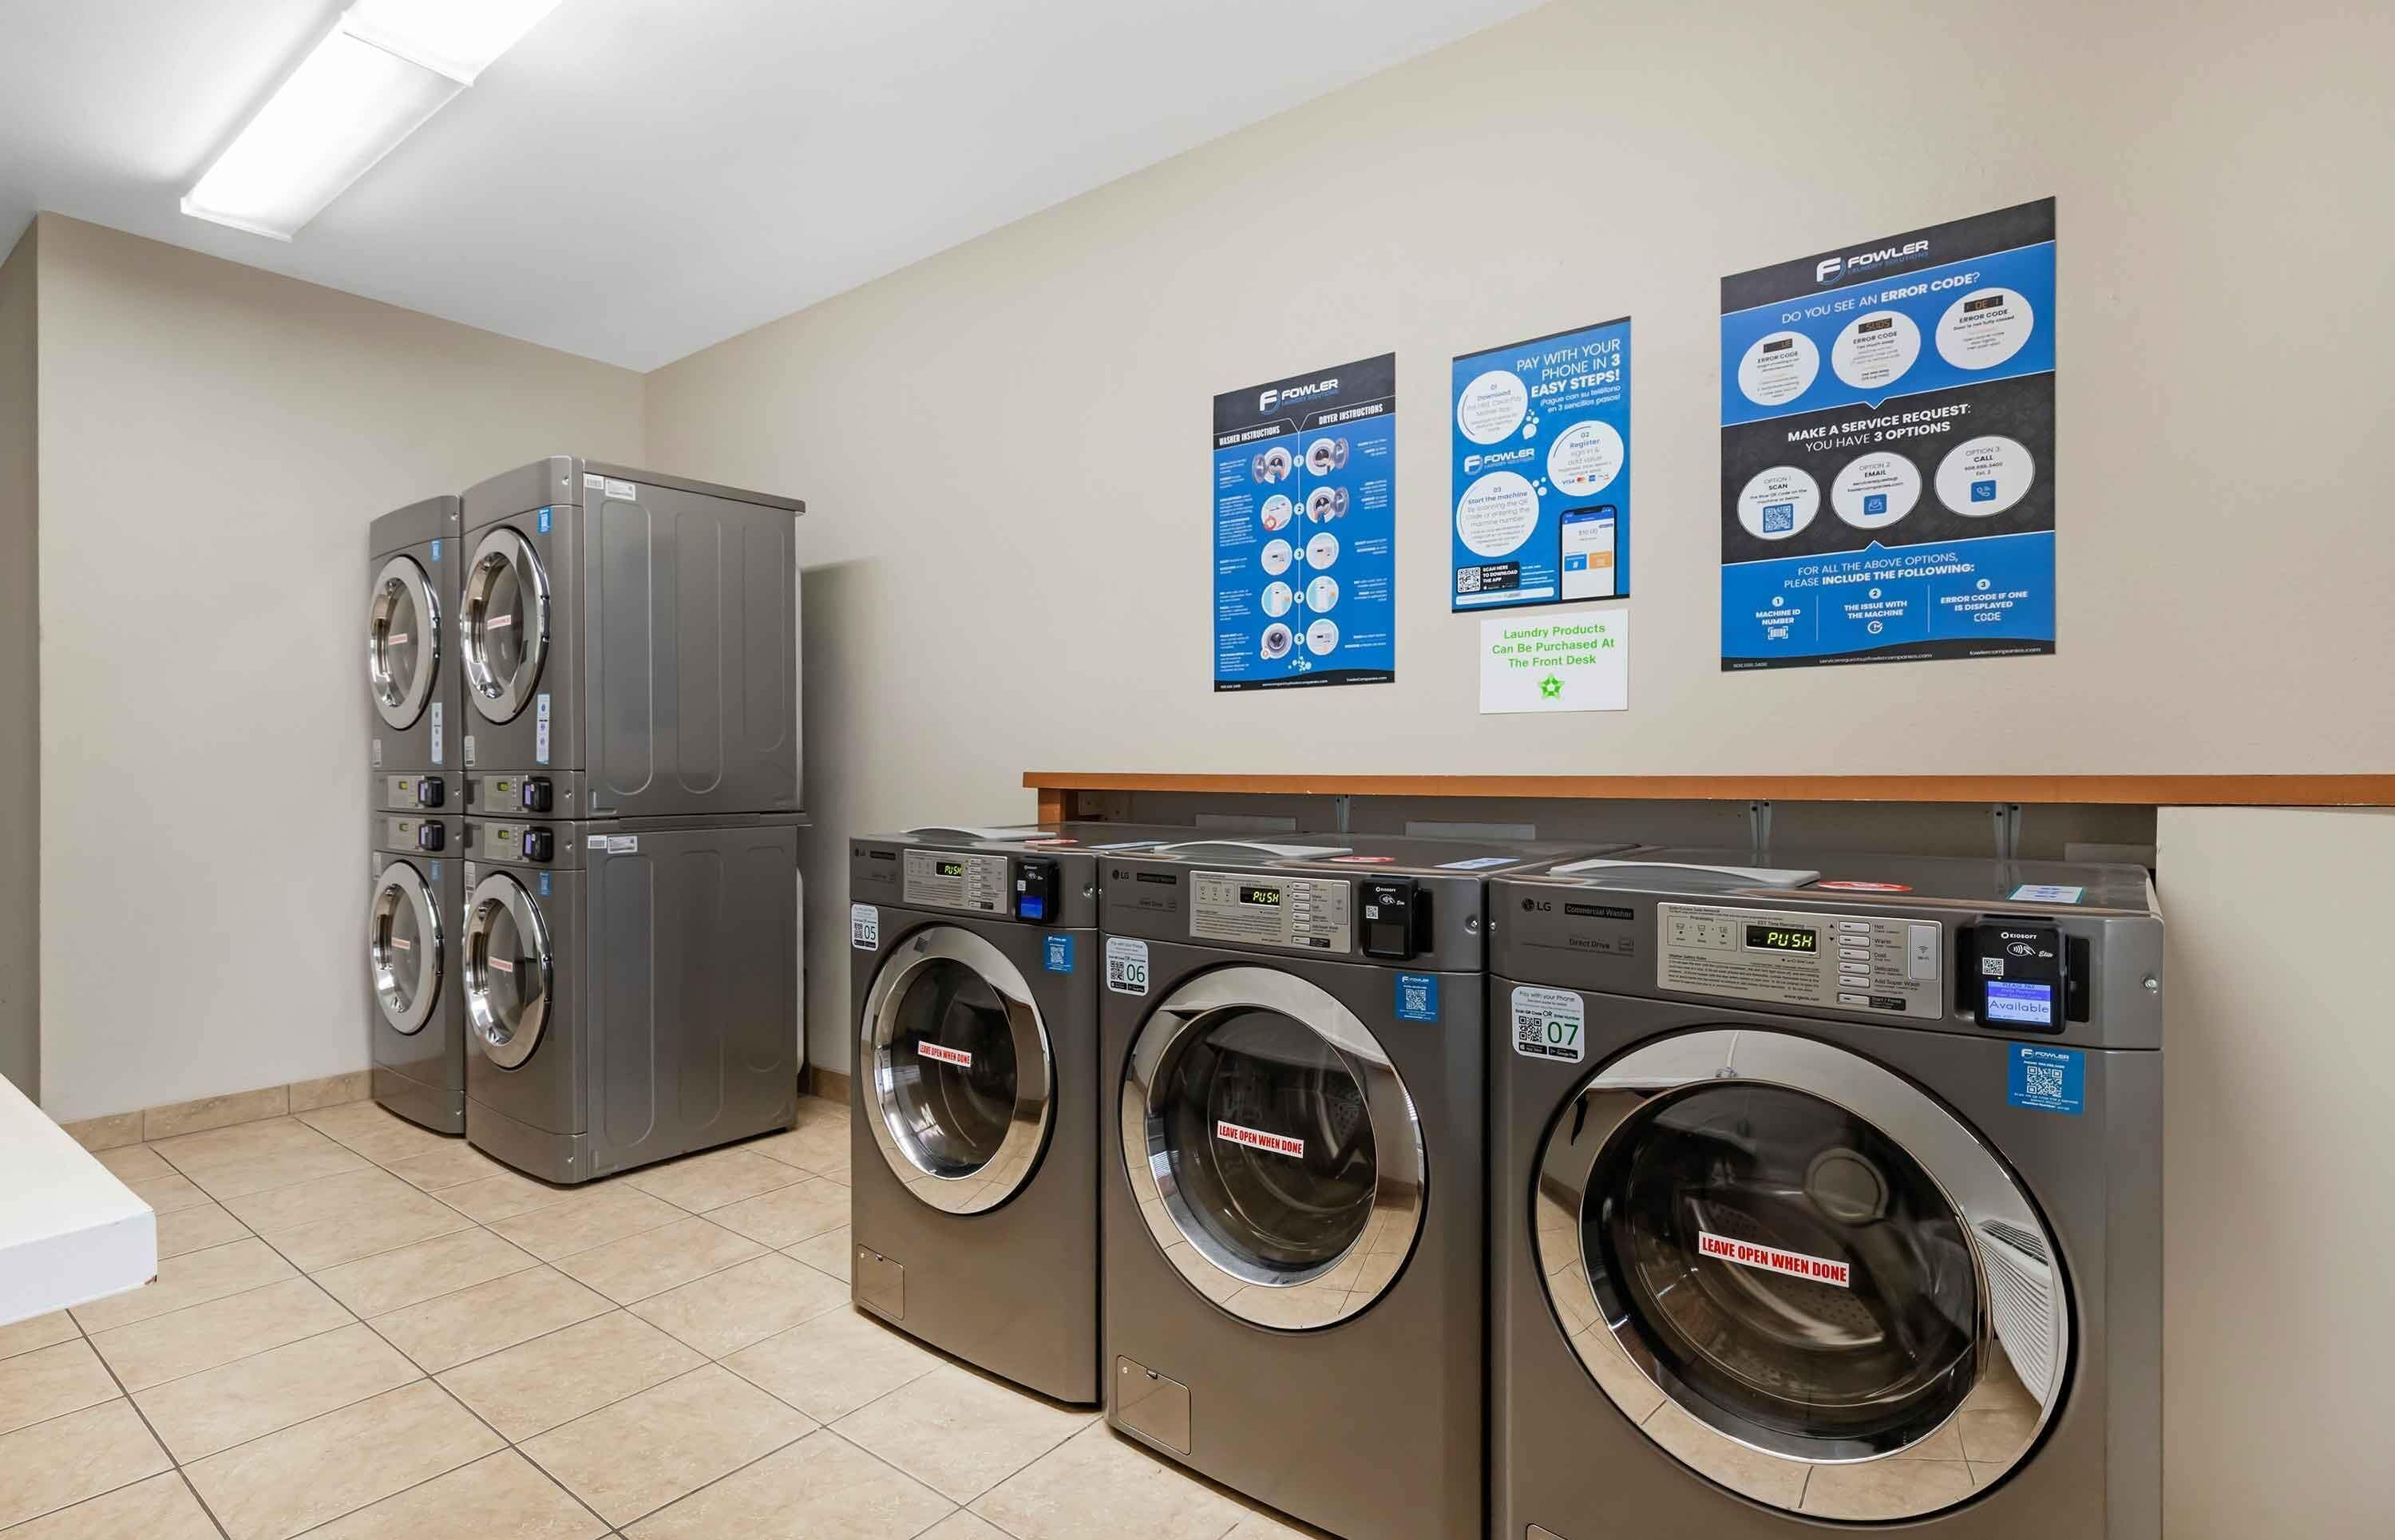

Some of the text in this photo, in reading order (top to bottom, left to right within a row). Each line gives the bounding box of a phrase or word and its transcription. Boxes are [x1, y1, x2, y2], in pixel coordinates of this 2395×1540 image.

[1847, 240, 1929, 268] FOWLER
[1782, 271, 1980, 324] DO YOU SEE AN ERROR CODE?
[1959, 309, 2009, 323] ERROR CODE
[1853, 331, 1898, 345] ERROR CODE
[1517, 338, 1621, 372] PAY WITH YOUR
[1757, 351, 1798, 364] ERROR CODE
[1542, 353, 1620, 381] PHONE IN 3
[1281, 378, 1339, 400] FOWLER
[1531, 369, 1620, 398] EASY STEPS!
[1319, 404, 1384, 425] DRYER INSTRUCTIONS
[1787, 403, 1972, 442] MAKE A SERVICE REQUEST:
[1219, 426, 1281, 445] WASHER INSTRUCTIONS
[1806, 422, 1950, 453] YOU HAVE 3 OPTIONS
[1570, 439, 1600, 448] Register
[1484, 448, 1535, 464] FOWLER
[1965, 447, 1993, 457] OPTION
[1859, 462, 1886, 471] OPTION
[1864, 469, 1886, 478] EMAIL
[1497, 491, 1528, 501] machine
[1798, 552, 1958, 576] FOR ALL THE ABOVE OPTIONS,
[1784, 564, 1975, 588] PLEASE INCLUDE THE FOLLOWING:
[1941, 596, 1969, 604] ERROR
[1971, 593, 1997, 602] CODE
[1965, 600, 2013, 611] DISPLAYED
[1861, 602, 1884, 611] ISSUE
[1864, 609, 1903, 619] MACHINE
[1973, 612, 2001, 622] CODE
[1504, 624, 1605, 639] Laundry Products
[1492, 638, 1615, 655] Can Be Purchased At
[1508, 654, 1597, 668] The Front Desk
[944, 865, 962, 875] PUSH
[1253, 892, 1279, 903] PUSH
[1537, 901, 1552, 912] LG
[1566, 905, 1632, 919] Commercial Washer
[865, 925, 876, 940] 05
[1767, 932, 1813, 948] PUSH
[1570, 938, 1610, 950] Direct Drive
[1127, 964, 1145, 983] 06
[1989, 1000, 2049, 1013] Available
[1547, 1021, 1578, 1046] 07
[920, 1044, 970, 1063] LEAVE OPEN WHEN DONE
[1220, 1125, 1302, 1154] LEAVE OPEN WHEN DONE
[1702, 1237, 1847, 1282] LEAVE OPEN WHEN DONE
